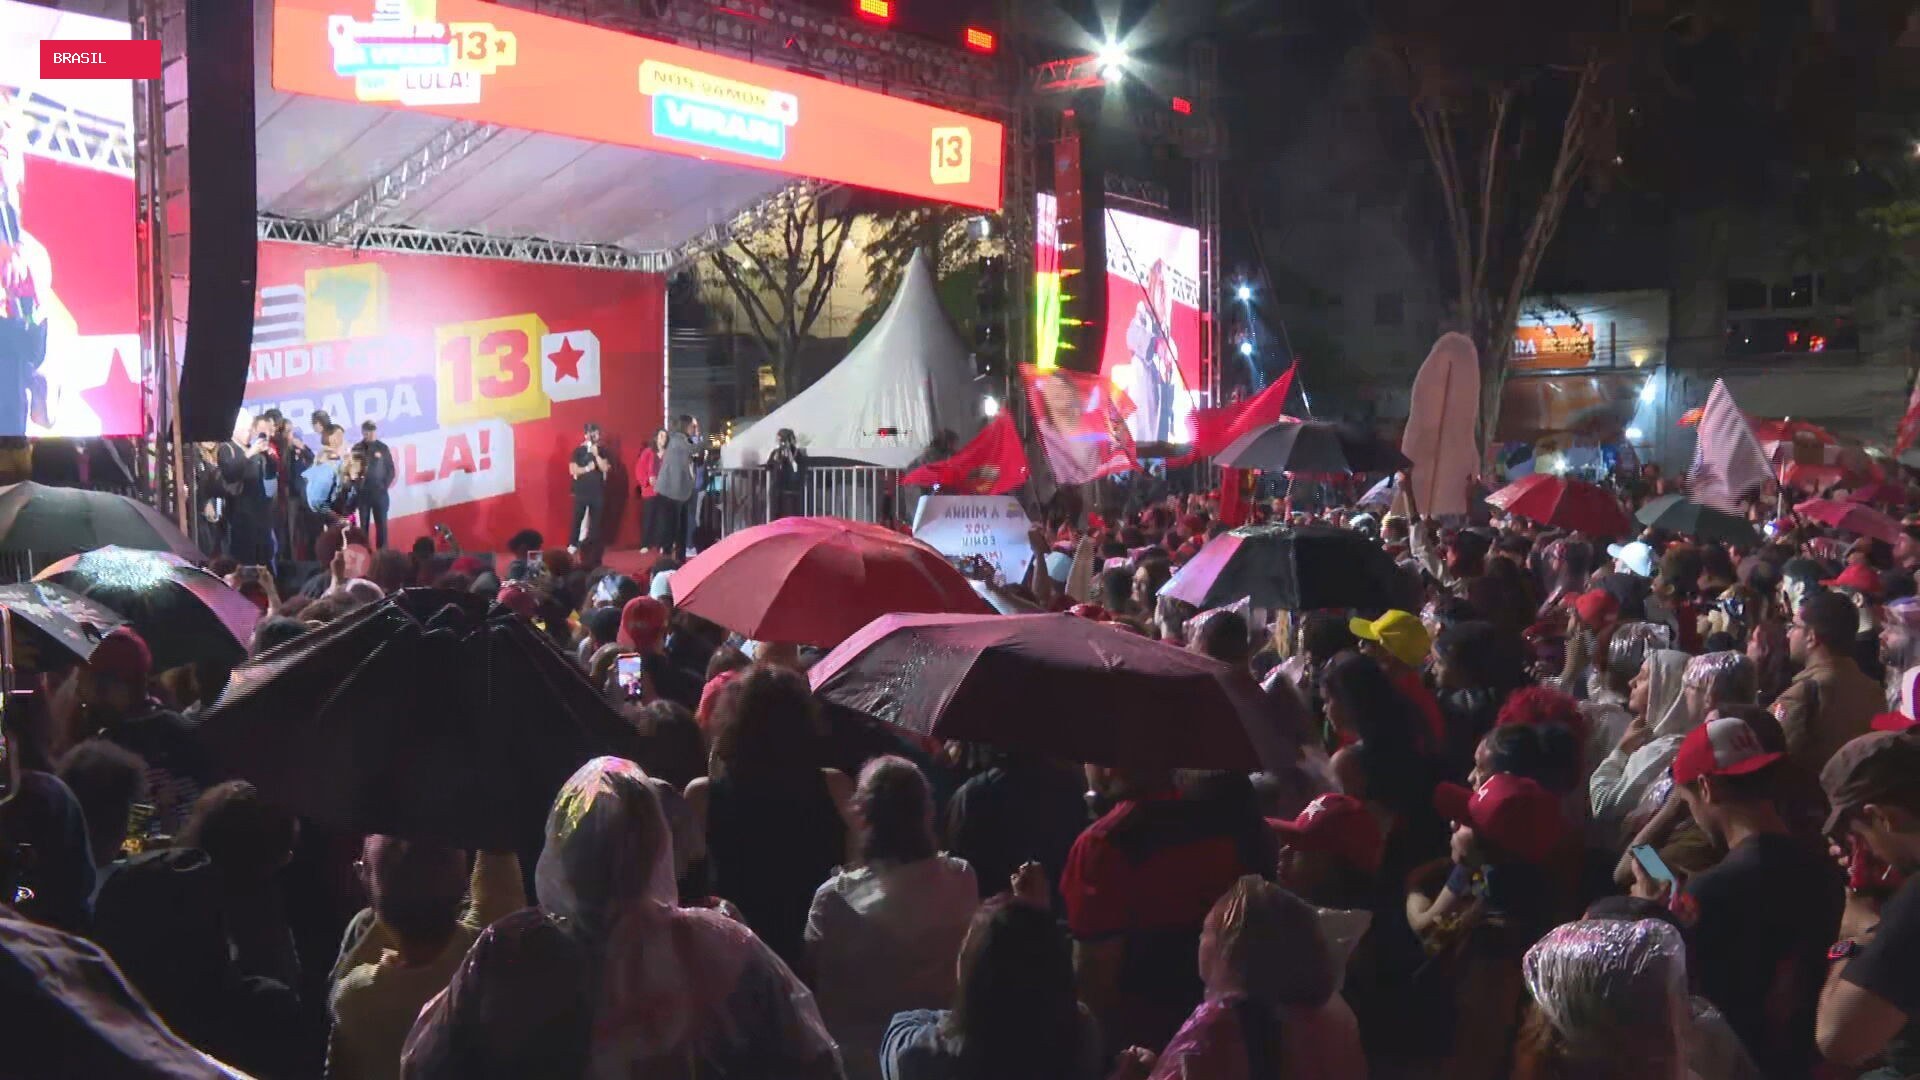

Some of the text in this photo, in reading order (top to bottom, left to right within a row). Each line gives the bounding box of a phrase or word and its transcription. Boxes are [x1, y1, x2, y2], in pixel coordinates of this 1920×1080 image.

[452, 31, 488, 60] 13
[405, 72, 470, 90] LULA!
[935, 135, 963, 168] 13
[442, 328, 531, 402] 13
